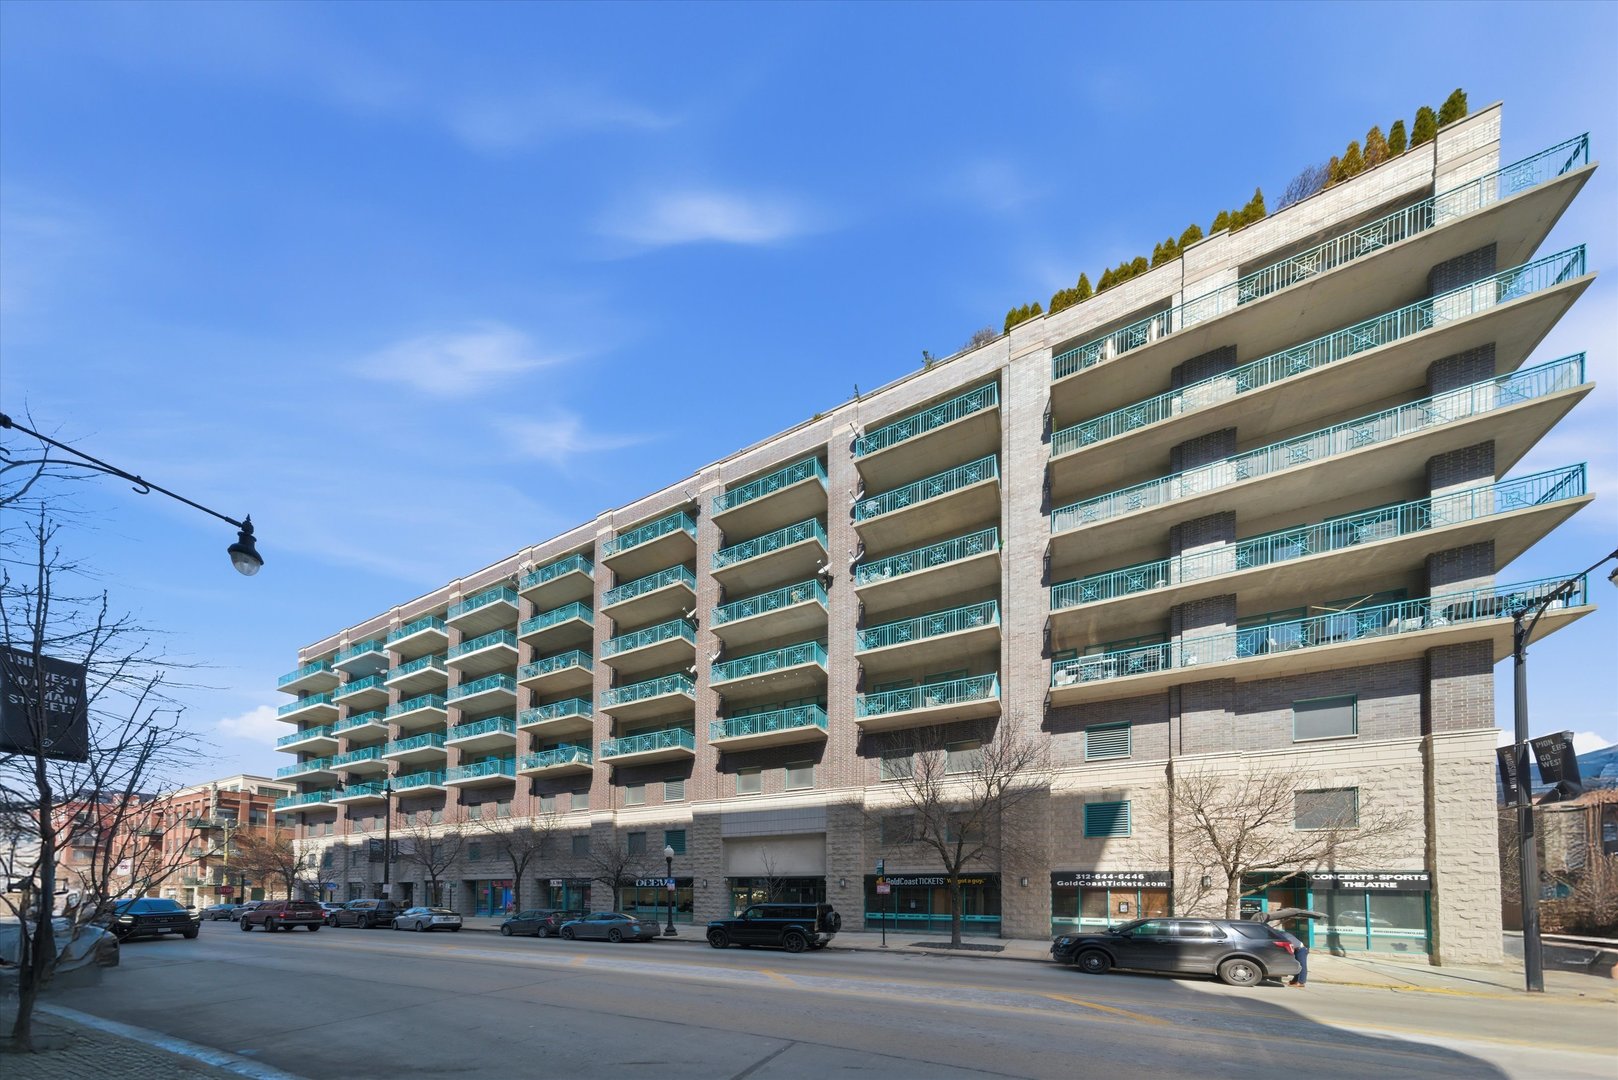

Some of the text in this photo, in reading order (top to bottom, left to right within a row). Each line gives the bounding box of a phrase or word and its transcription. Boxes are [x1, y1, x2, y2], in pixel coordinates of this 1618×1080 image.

[919, 877, 944, 885] TICKETS
[1311, 873, 1429, 882] CONCERTS SPORTS
[1342, 881, 1398, 889] THEATRE
